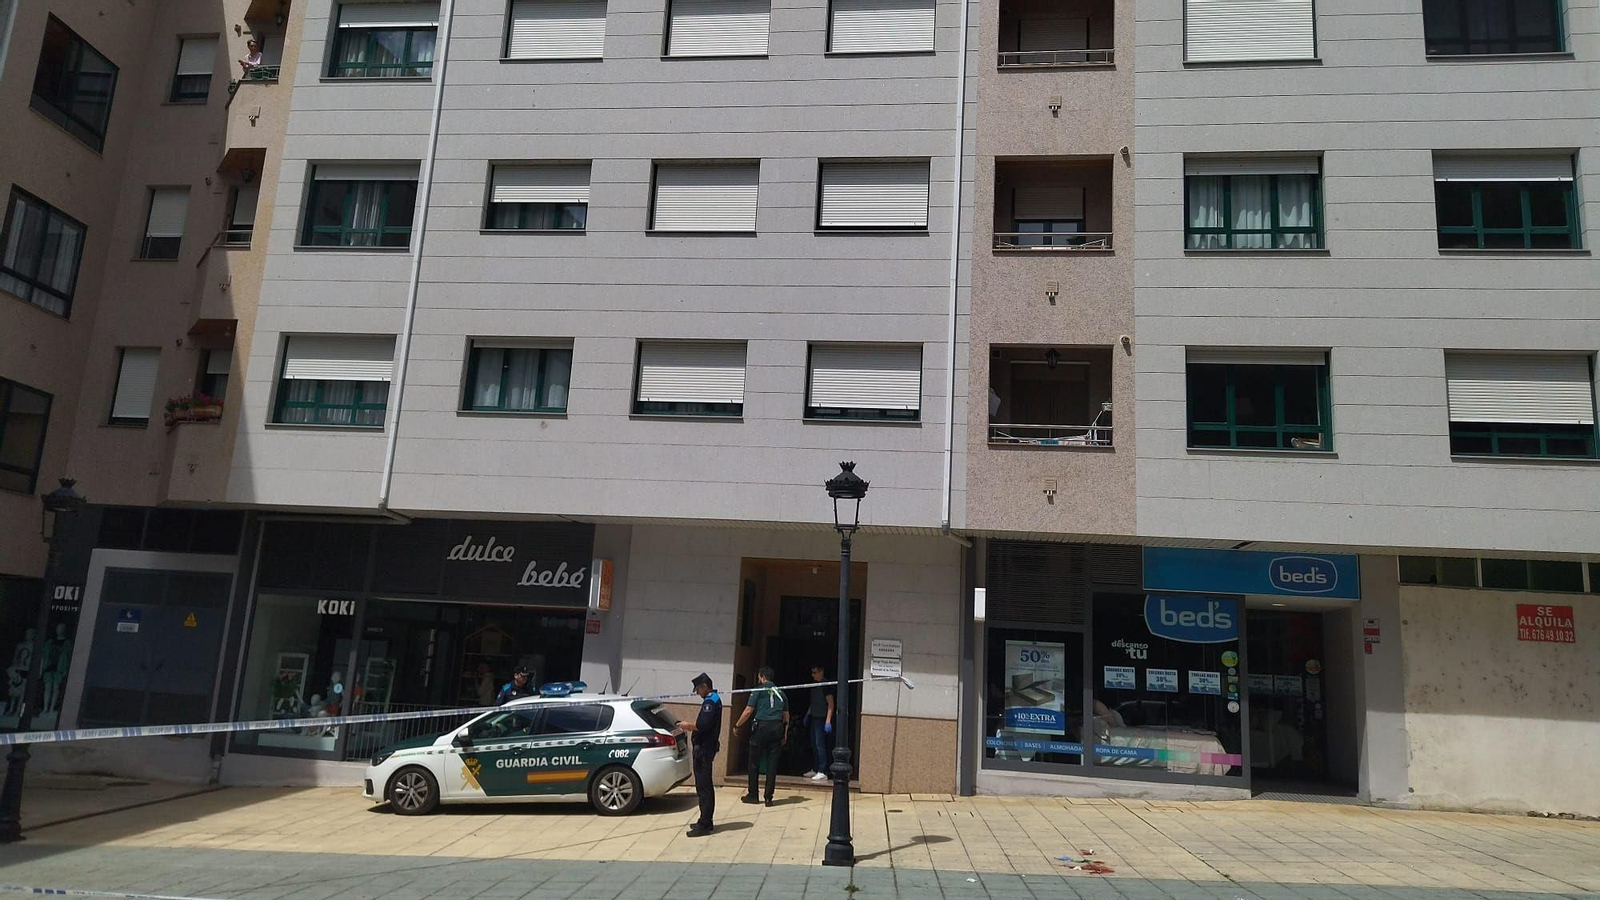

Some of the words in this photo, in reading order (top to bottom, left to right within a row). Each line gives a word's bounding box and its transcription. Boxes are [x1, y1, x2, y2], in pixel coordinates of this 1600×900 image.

[447, 535, 515, 562] dulce
[517, 560, 587, 588] bebé
[1279, 565, 1327, 584] bed's
[52, 585, 80, 601] OKi
[1159, 599, 1232, 629] bed's
[1537, 606, 1553, 616] SE
[1519, 616, 1573, 628] ALQUILA
[1531, 629, 1545, 640] 676
[1555, 630, 1564, 641] 10
[1564, 631, 1574, 642] 32
[1020, 649, 1050, 663] 50%
[1030, 713, 1057, 722] EXTRA
[495, 757, 548, 769] GUARDIA
[551, 756, 583, 766] CIVIL
